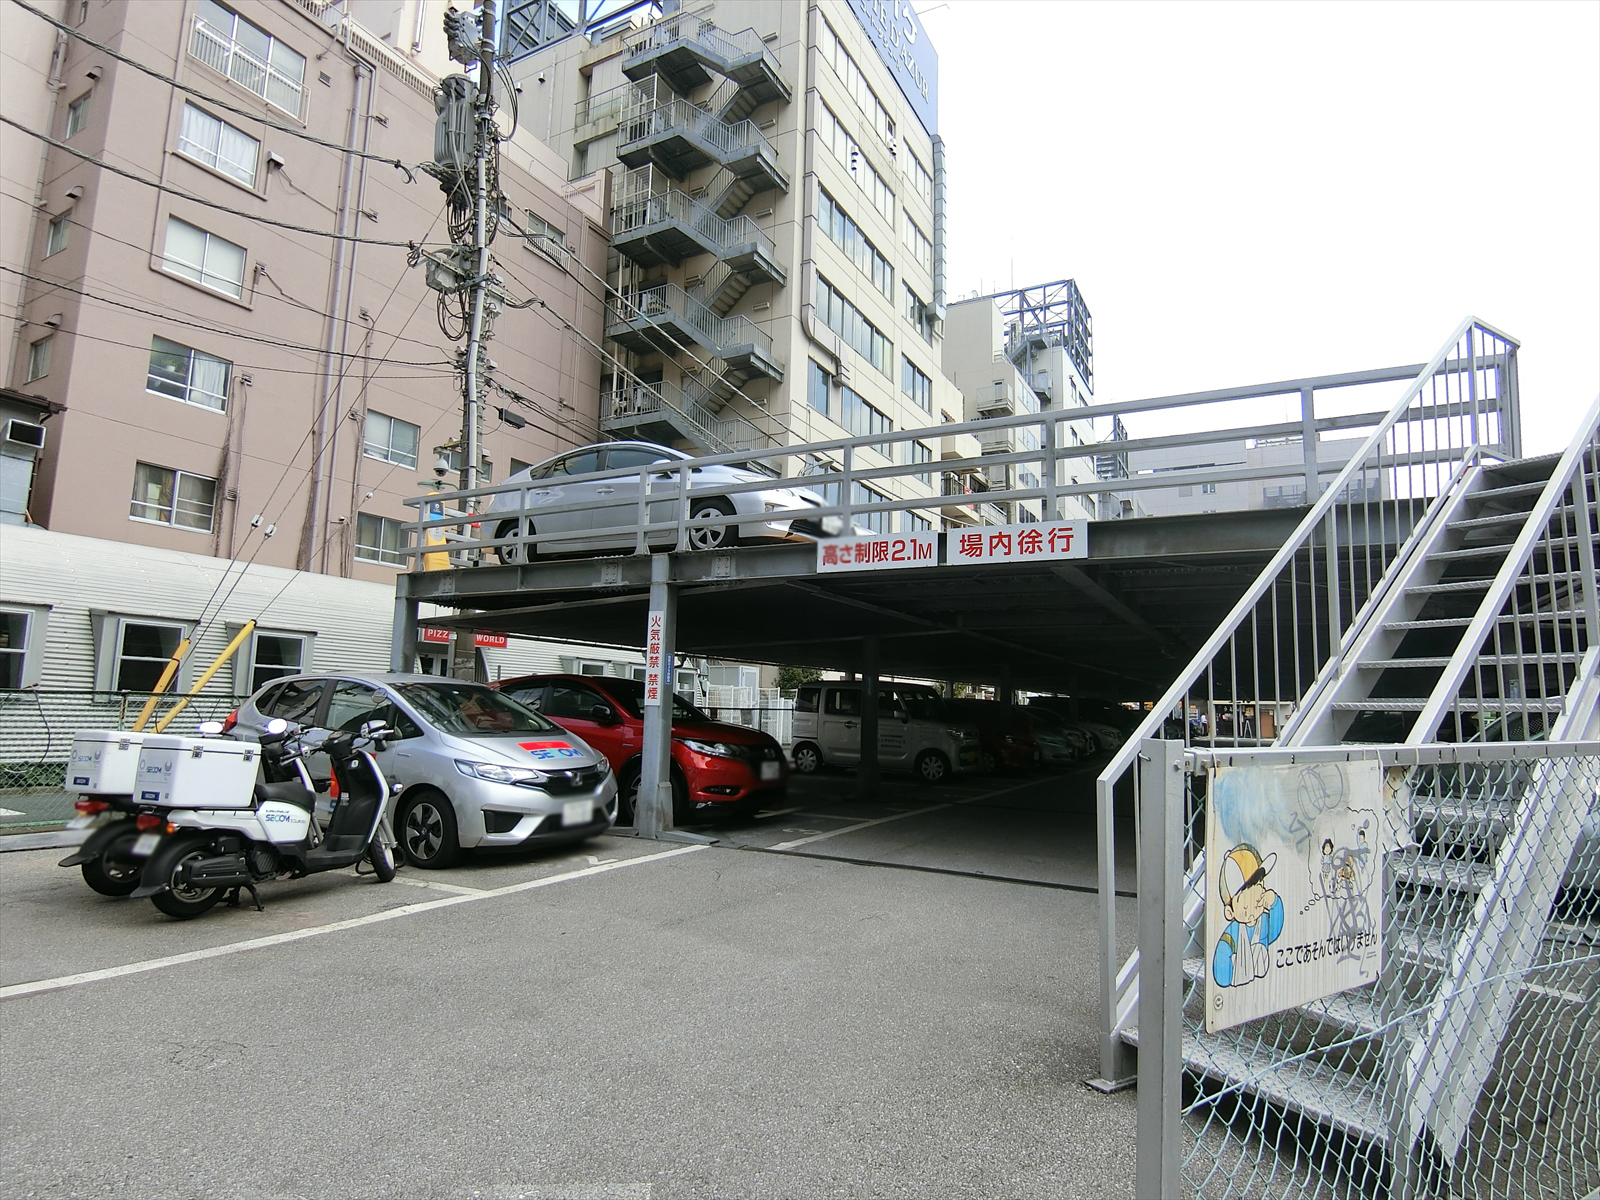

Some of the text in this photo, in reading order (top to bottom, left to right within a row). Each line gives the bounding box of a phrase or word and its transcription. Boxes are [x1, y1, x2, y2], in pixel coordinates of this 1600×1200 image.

[959, 526, 1075, 558] 場内徐行
[476, 634, 505, 644] WORLD
[647, 615, 661, 700] 火気厳禁 禁煙
[530, 748, 585, 760] SECOM
[146, 766, 162, 774] SECOM
[265, 814, 290, 822] SECOM
